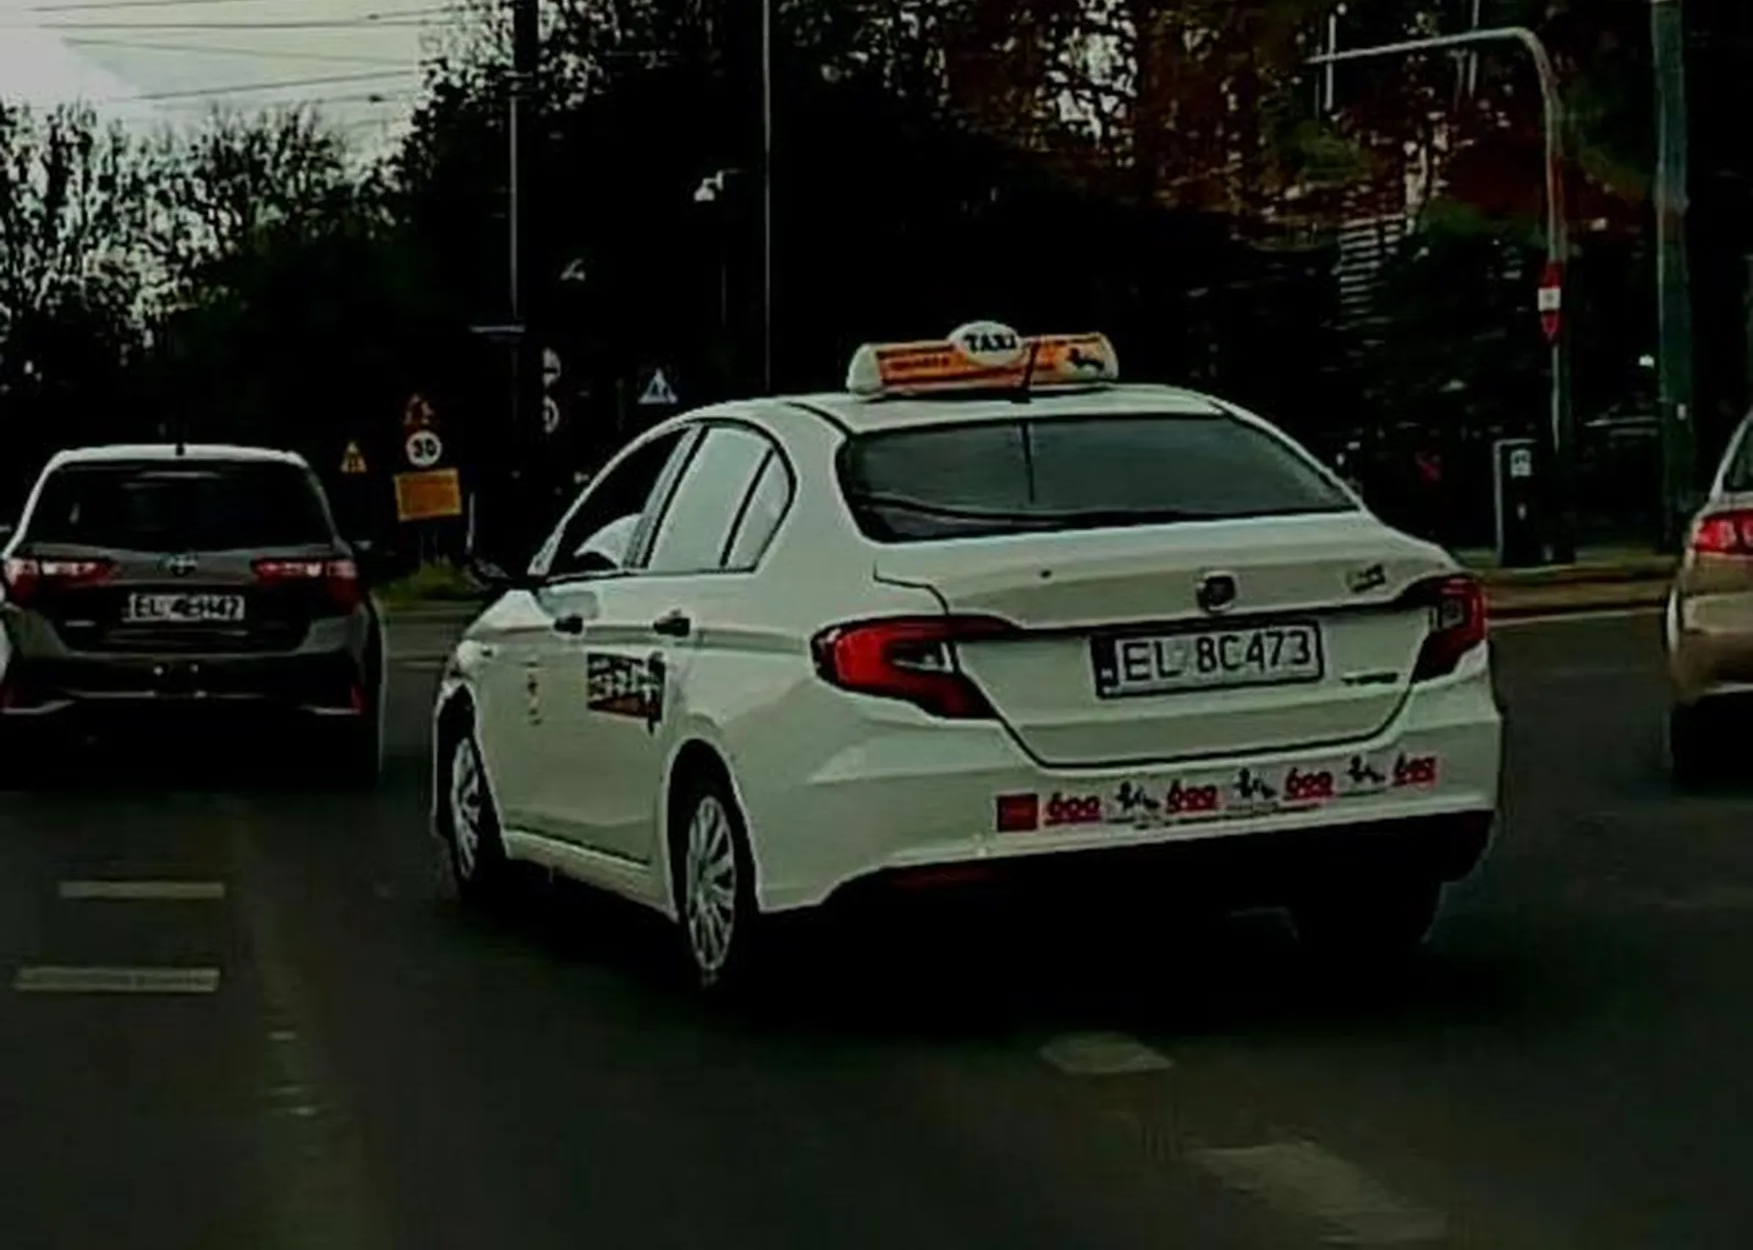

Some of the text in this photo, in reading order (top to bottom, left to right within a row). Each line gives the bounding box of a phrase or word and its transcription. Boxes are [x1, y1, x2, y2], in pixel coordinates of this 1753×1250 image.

[964, 333, 1016, 352] TAXI
[412, 438, 438, 458] 30
[1121, 630, 1312, 681] EL 8C473
